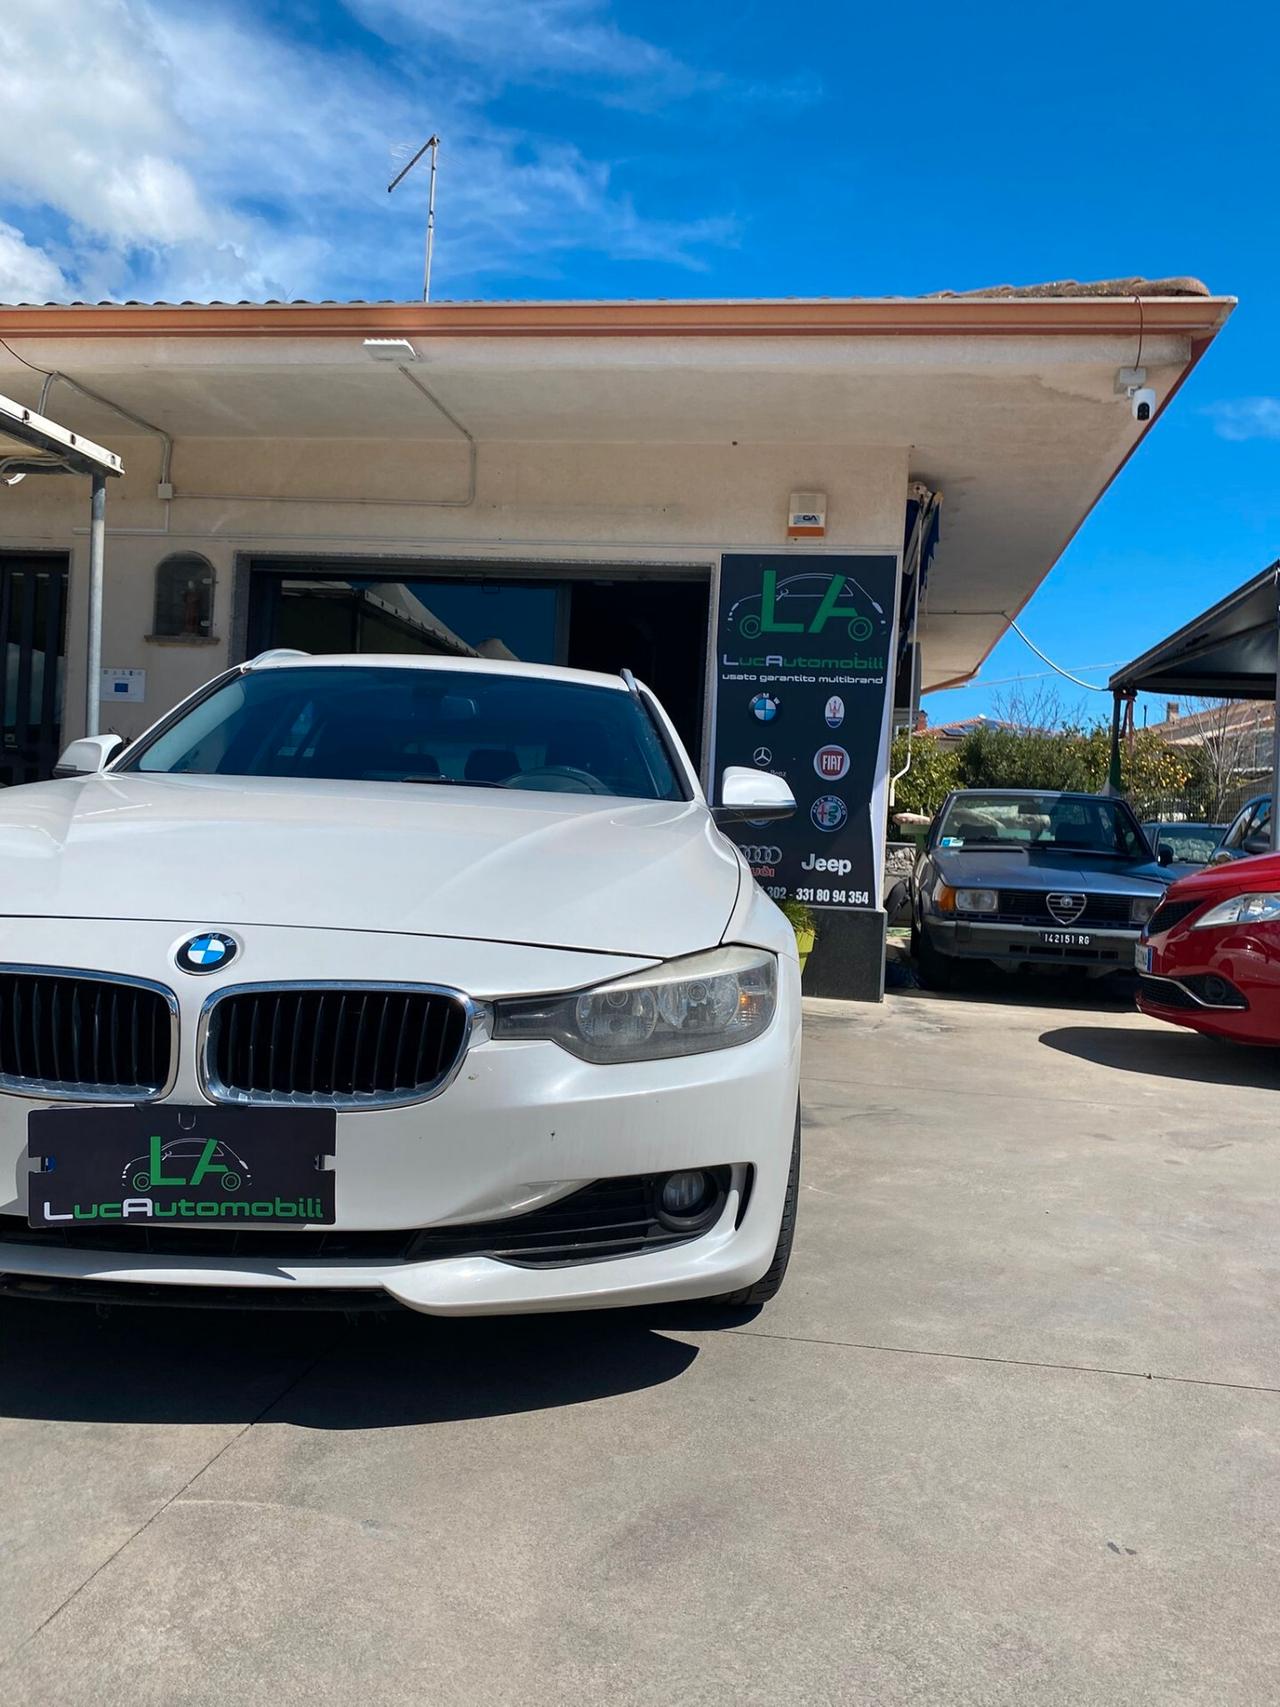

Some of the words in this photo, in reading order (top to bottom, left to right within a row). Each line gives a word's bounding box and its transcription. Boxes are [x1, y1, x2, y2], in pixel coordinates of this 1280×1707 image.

[760, 570, 858, 633] LA
[722, 653, 884, 669] LucAutomobili
[759, 674, 816, 683] garantito
[818, 674, 884, 684] multibrand
[822, 754, 843, 771] FIAT
[750, 865, 775, 878] udi
[801, 853, 852, 876] Jeep
[795, 887, 814, 901] 331
[816, 889, 830, 902] 80
[832, 890, 846, 903] 94
[848, 891, 869, 905] 354
[187, 932, 236, 947] BMW
[1078, 935, 1090, 945] RG
[150, 1136, 229, 1185] LA
[43, 1197, 324, 1221] LucAutomobili
